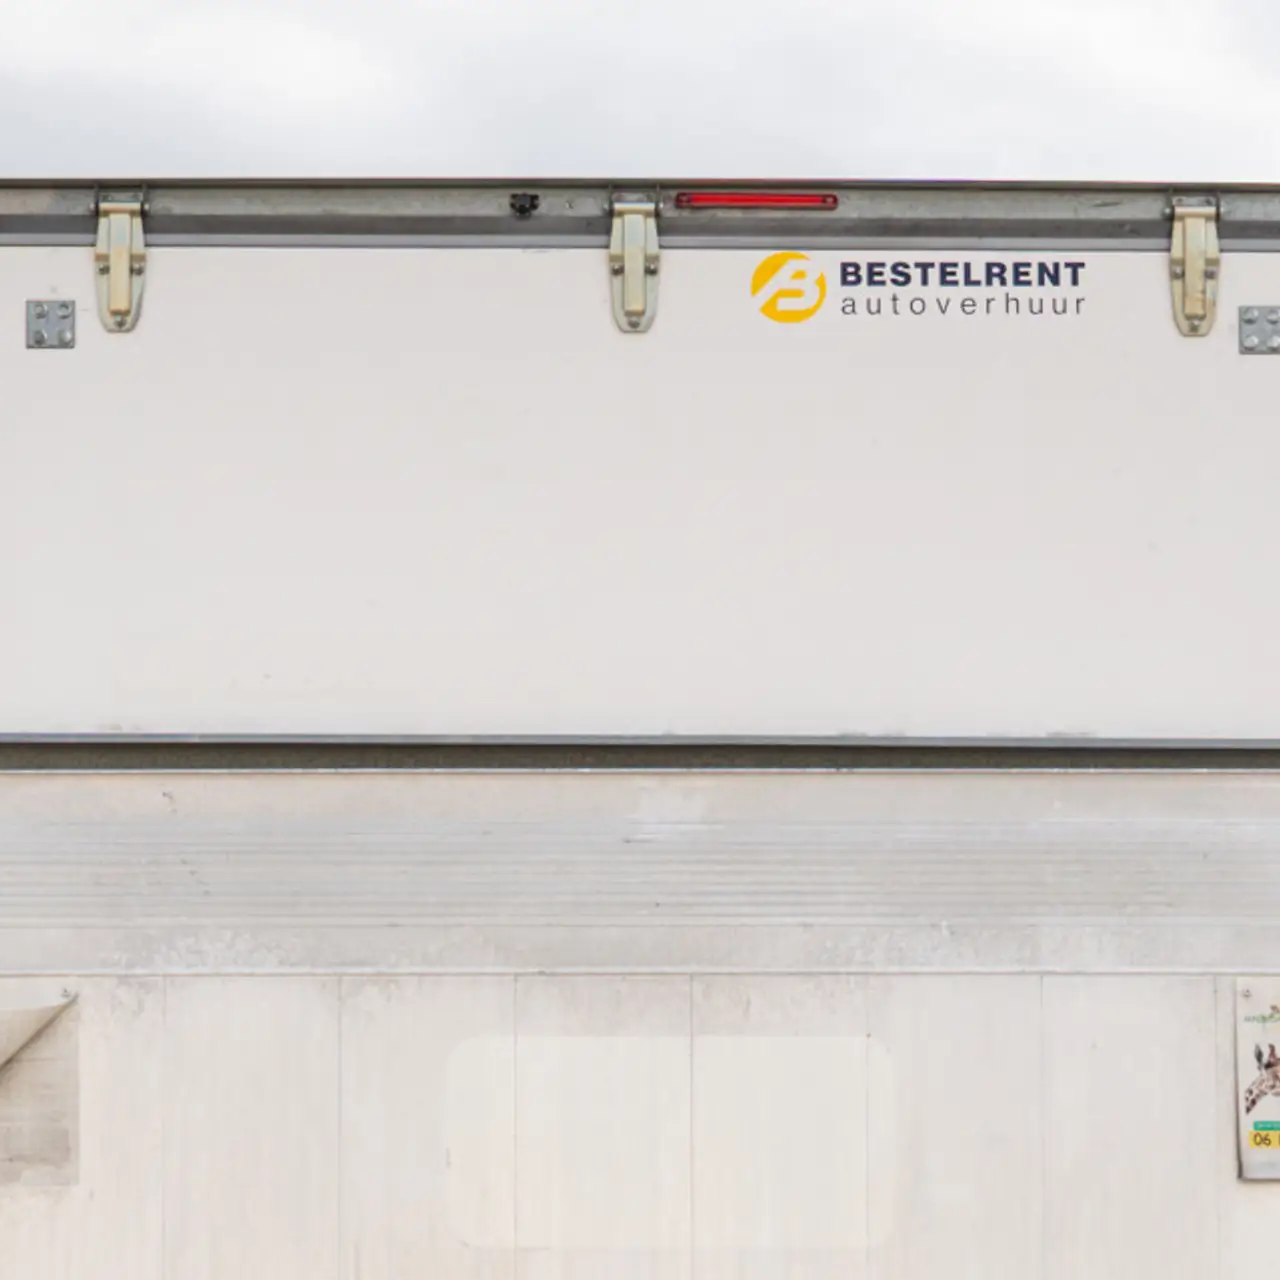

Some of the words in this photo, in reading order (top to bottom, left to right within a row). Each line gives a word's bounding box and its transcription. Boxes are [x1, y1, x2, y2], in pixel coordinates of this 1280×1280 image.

[840, 262, 1085, 287] BESTELRENT
[841, 293, 1085, 315] autoverhuur
[1253, 1132, 1271, 1147] 06
